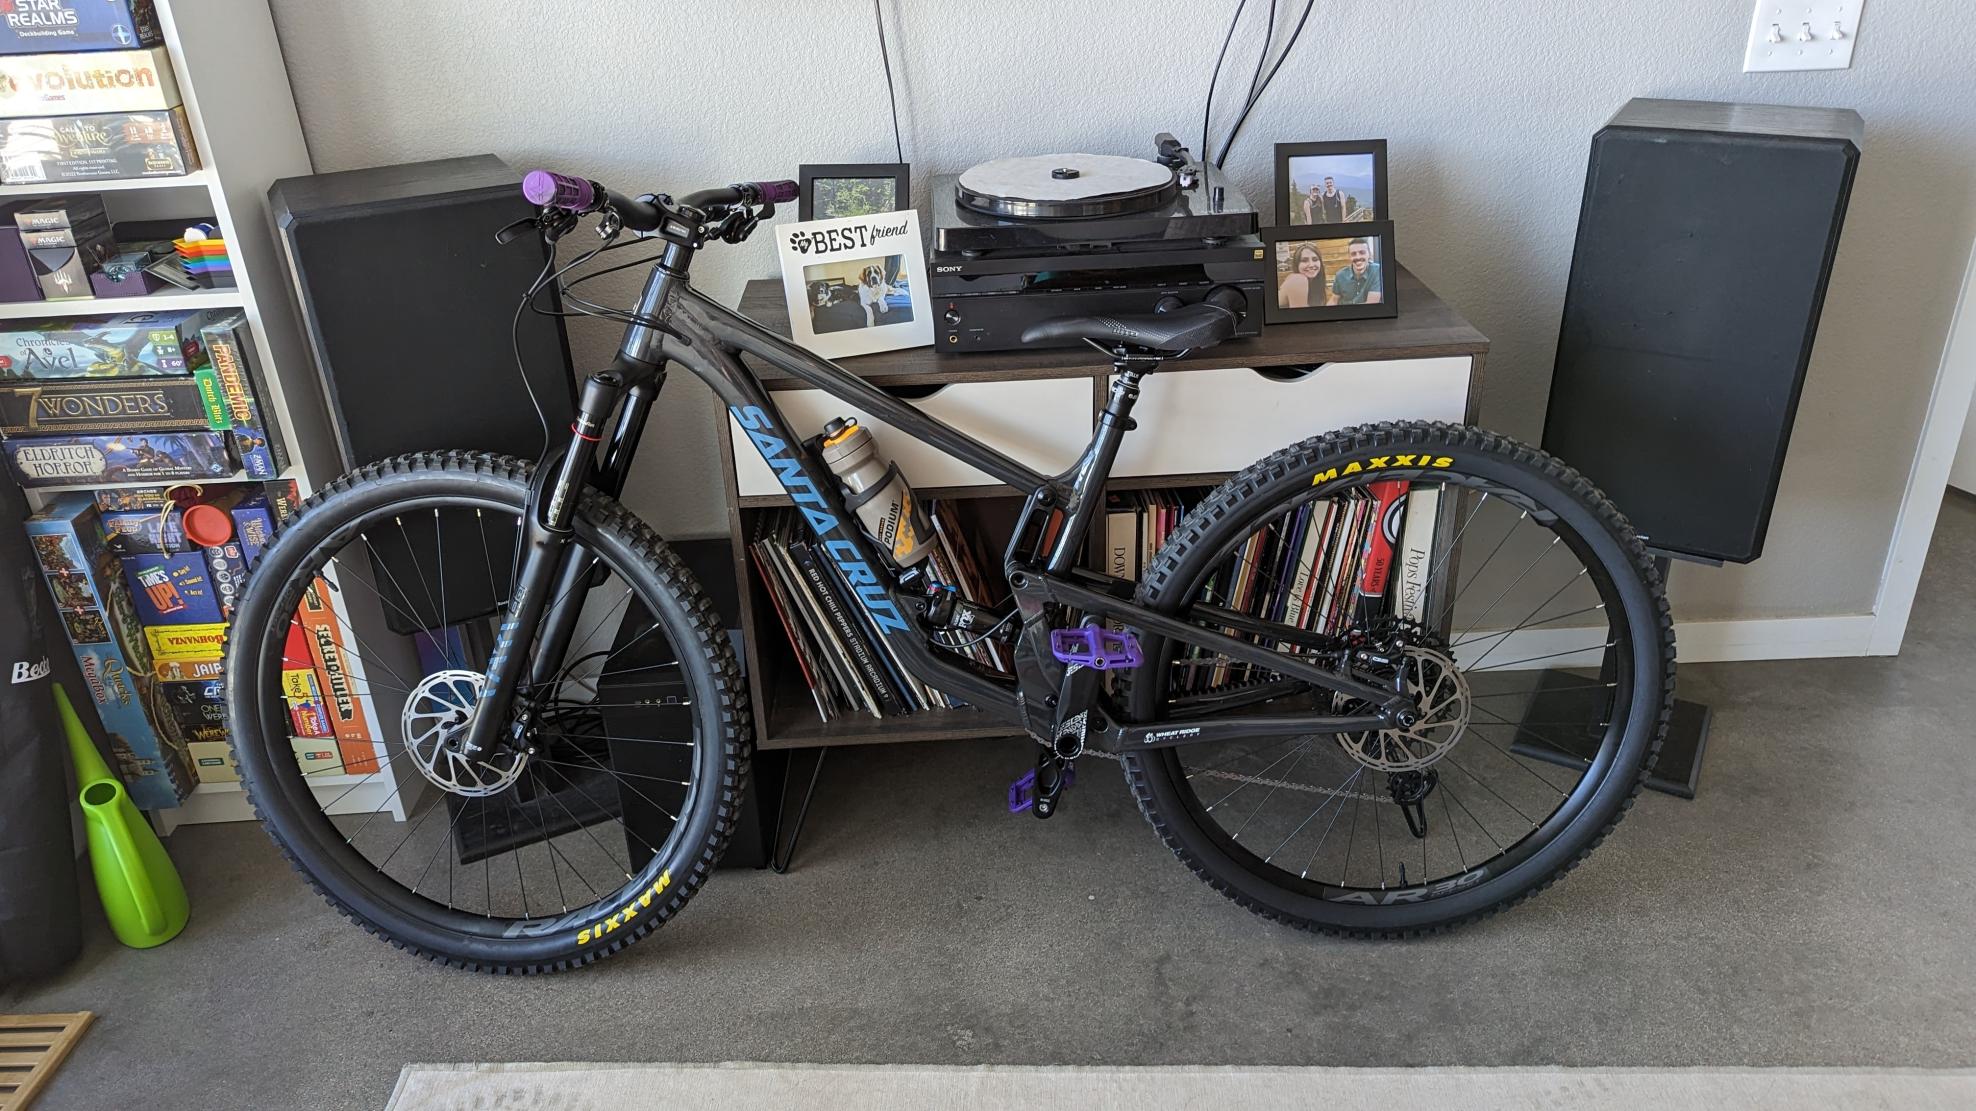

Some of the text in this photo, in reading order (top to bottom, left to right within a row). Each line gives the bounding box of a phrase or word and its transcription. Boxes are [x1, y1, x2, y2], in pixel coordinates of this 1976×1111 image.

[8, 11, 78, 27] REALMS
[32, 217, 60, 225] MAGIC
[38, 236, 66, 244] MAGIC
[812, 225, 868, 254] BEST
[870, 220, 908, 246] friend
[16, 338, 71, 347] Chronicles
[22, 347, 78, 371] Avel
[203, 378, 218, 403] Dutch
[213, 344, 251, 421] PANDEMIC
[14, 387, 169, 428] 7 WONDERS
[24, 446, 95, 462] ELDRITCH
[33, 461, 96, 477] HORROR
[1312, 455, 1455, 486] MAXXIS
[730, 405, 911, 635] SANTA CRUZ
[884, 502, 900, 545] PODIUM
[1113, 546, 1126, 578] DOW
[1404, 547, 1425, 579] Pops
[145, 581, 184, 610] UP!
[960, 609, 976, 629] FOX
[1287, 602, 1300, 623] Blue
[168, 634, 224, 646] BOHNANZA
[808, 567, 886, 695] RED HOT CHILI PEPPERS STADIUM ARCADIUM
[80, 656, 107, 705] MegaBox
[104, 656, 131, 706] Quacks
[193, 662, 222, 678] JAIP
[1156, 727, 1200, 738] WHEAT RIDGE
[577, 868, 672, 945] MAXXIS
